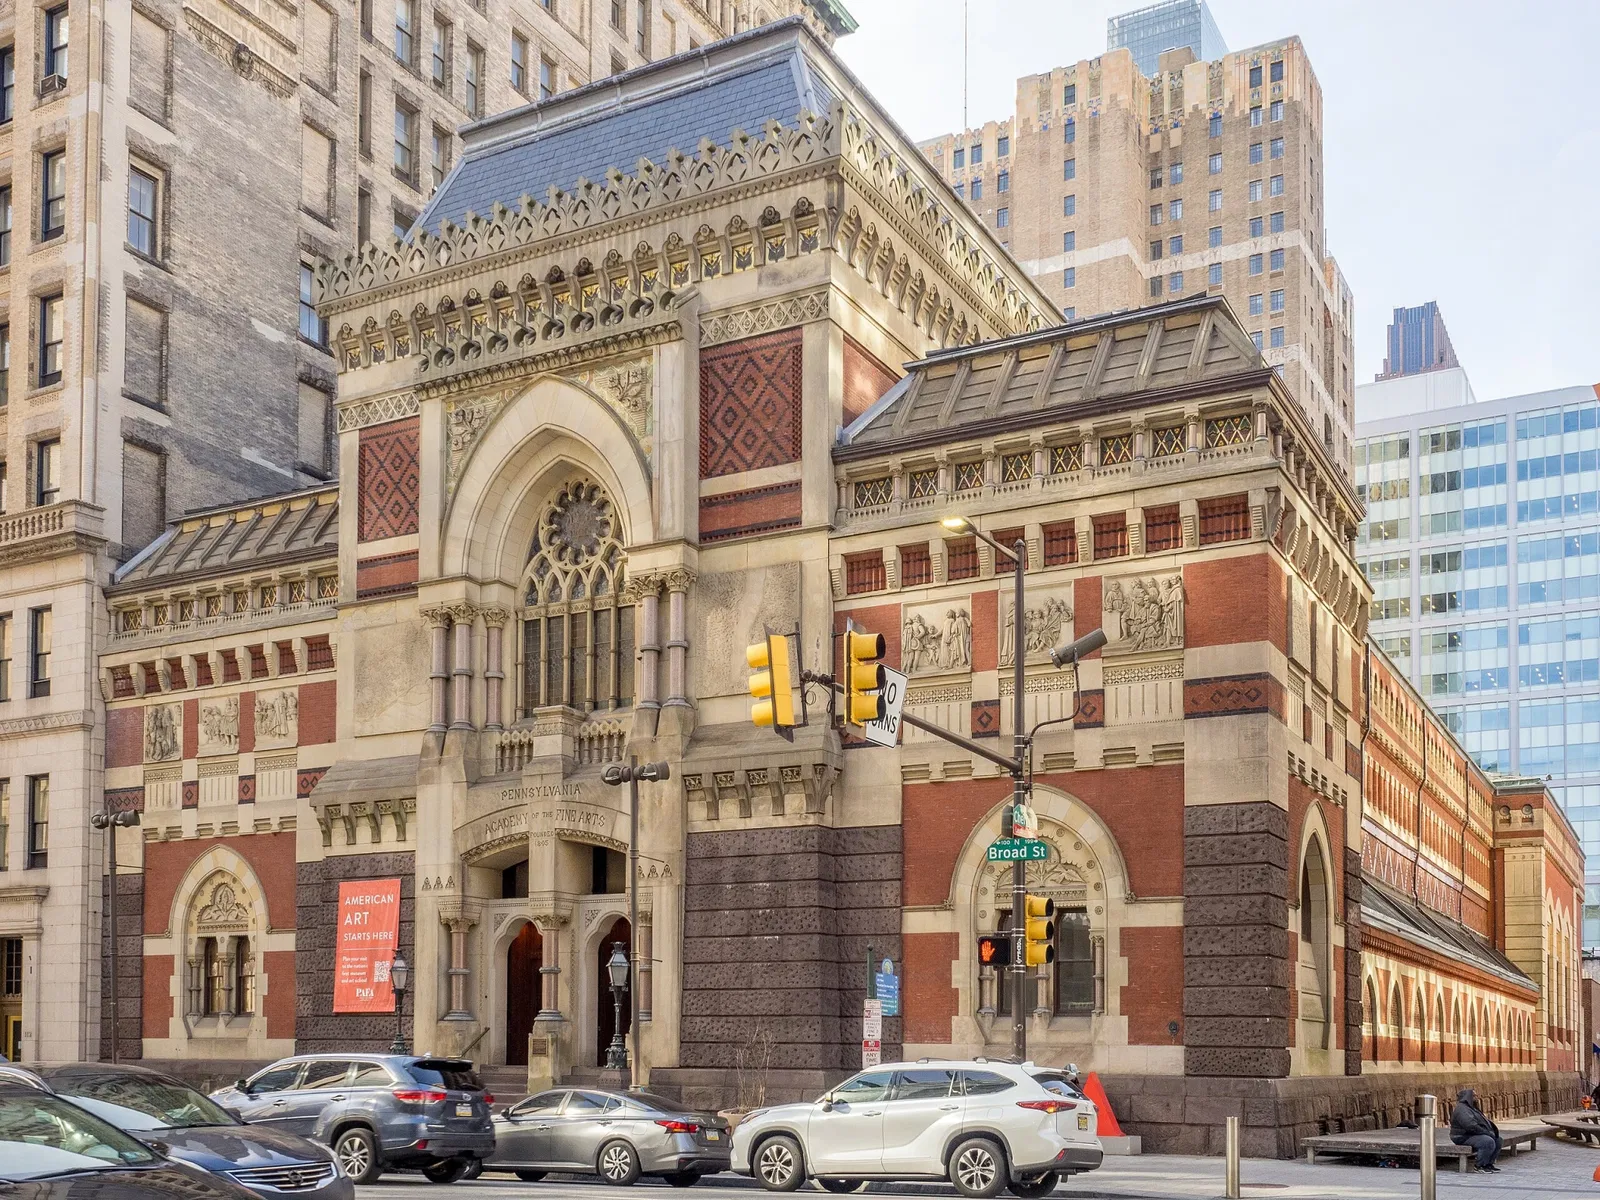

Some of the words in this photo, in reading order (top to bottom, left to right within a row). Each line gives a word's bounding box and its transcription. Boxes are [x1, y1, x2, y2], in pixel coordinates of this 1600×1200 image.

[501, 784, 581, 800] PENNSYLVANIA
[484, 812, 528, 835] ACADEMY
[555, 809, 576, 822] FINE
[578, 811, 605, 828] ARTS
[989, 846, 1027, 859] Broad
[1033, 846, 1045, 857] St
[344, 894, 394, 905] AMERICAN
[344, 911, 369, 926] ART
[343, 932, 371, 941] STARTS
[372, 931, 393, 940] HERE
[356, 987, 374, 997] PAFA
